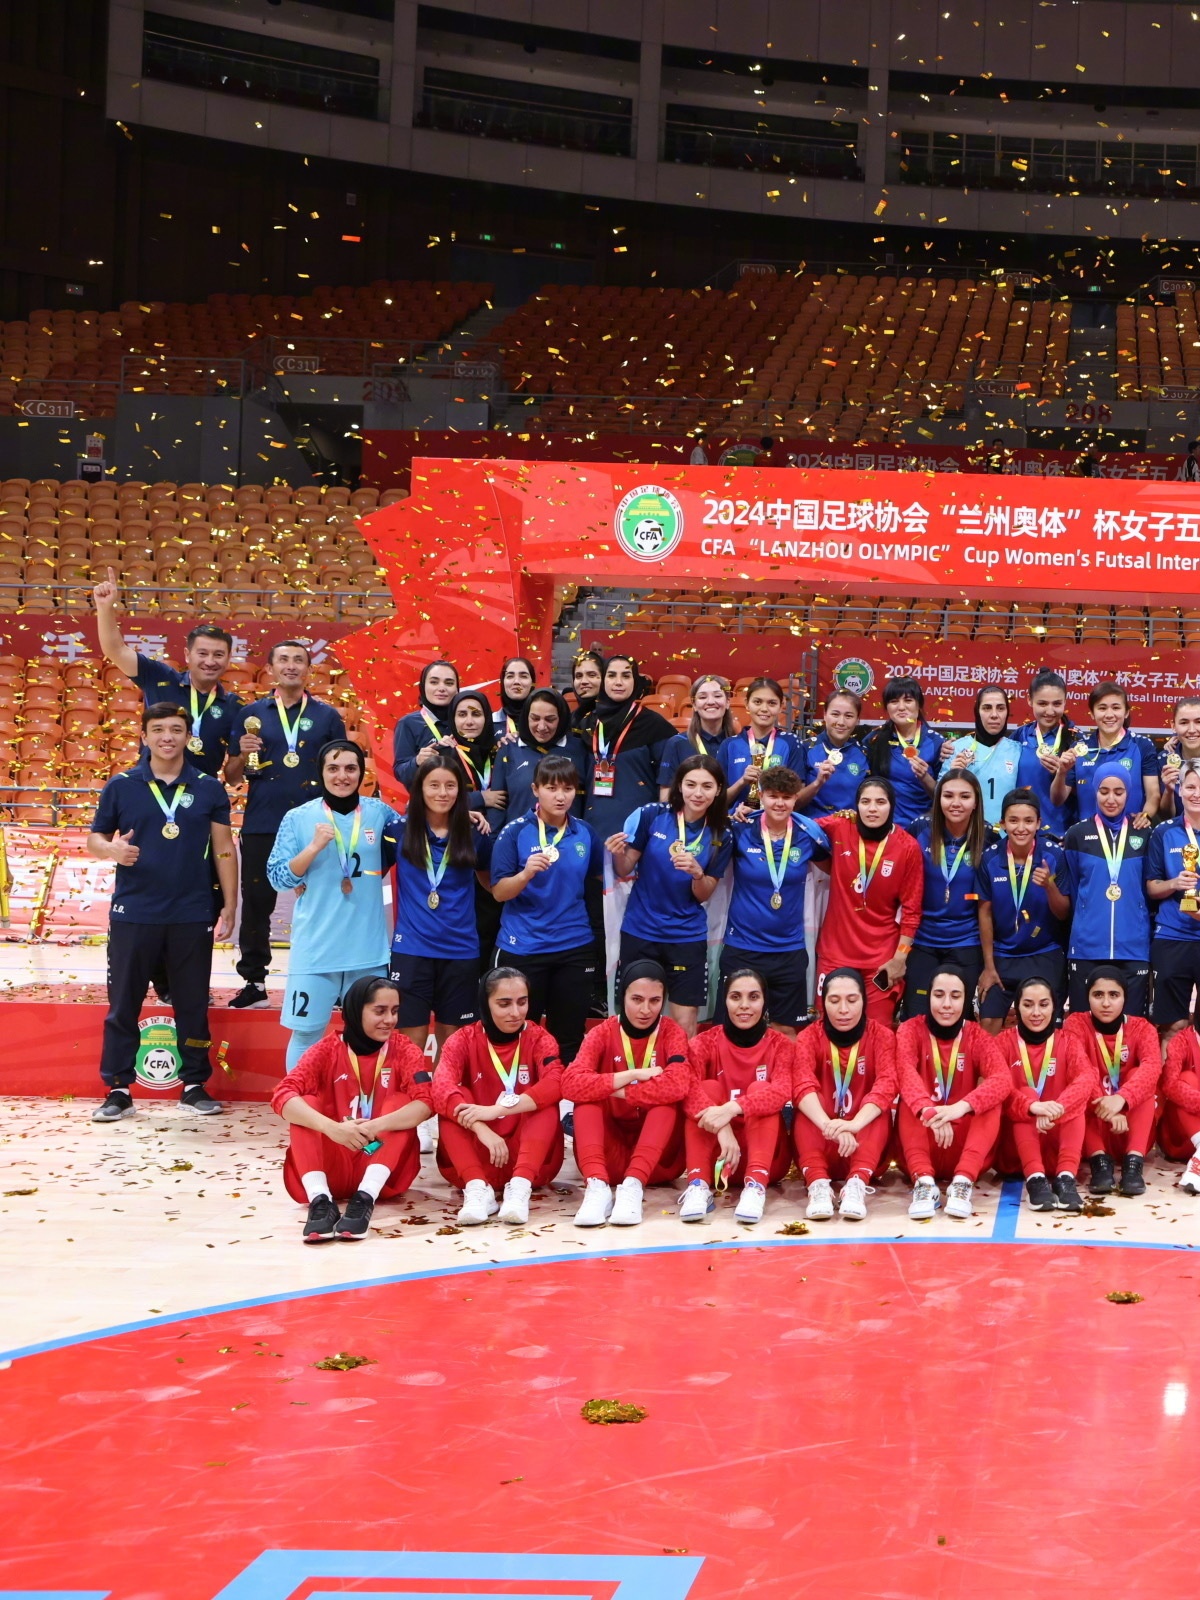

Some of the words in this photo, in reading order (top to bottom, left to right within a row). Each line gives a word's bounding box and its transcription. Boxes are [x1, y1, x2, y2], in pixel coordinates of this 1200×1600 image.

[287, 358, 316, 371] C311
[36, 402, 70, 416] C311
[703, 498, 931, 534] 2024中国足球协会
[639, 531, 658, 541] CFA
[701, 538, 735, 556] CFA
[963, 546, 1000, 568] Cup
[1005, 547, 1090, 568] Women's
[1095, 550, 1151, 571] Futsal
[885, 664, 1019, 684] 2024中国足球协会
[1026, 668, 1107, 687] “州奥体”
[923, 686, 974, 697] ANZHOU
[1127, 692, 1150, 702] utsal
[987, 777, 996, 800] 1
[351, 853, 362, 878] 2
[509, 935, 516, 945] 12
[729, 927, 734, 935] 2
[390, 972, 400, 981] 22
[291, 989, 310, 1018] 12
[149, 1060, 170, 1069] CFA
[930, 1077, 942, 1102] 3
[1102, 1075, 1112, 1096] 9
